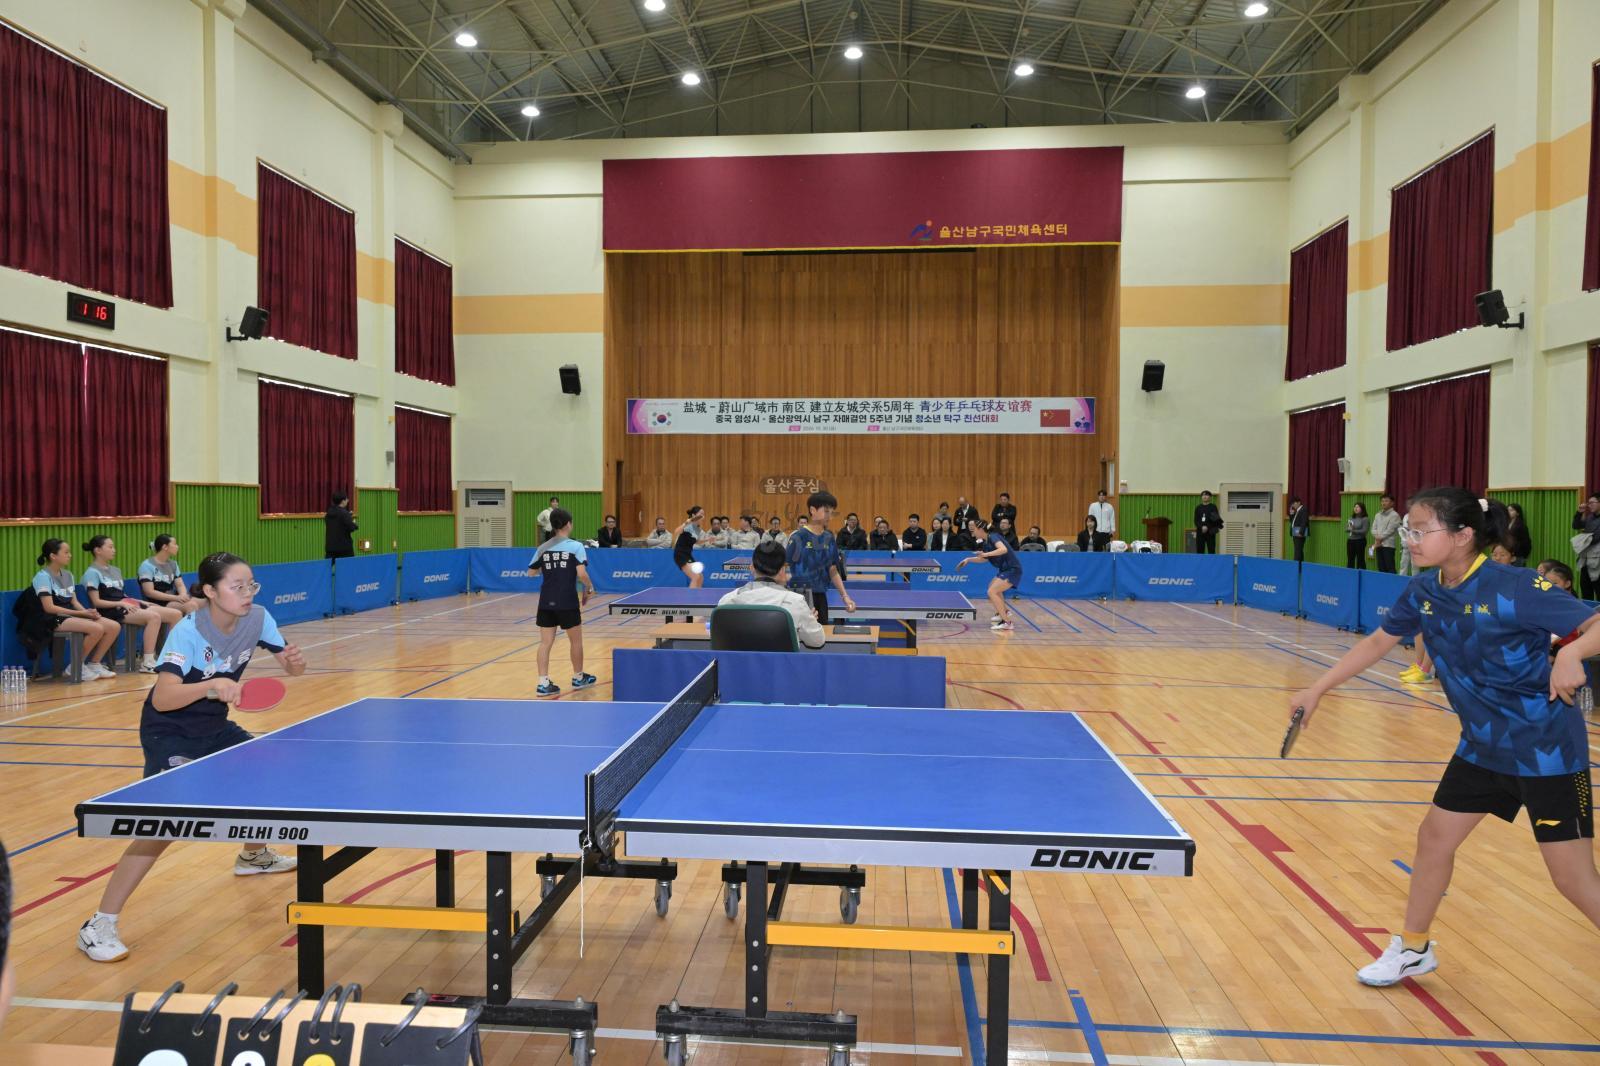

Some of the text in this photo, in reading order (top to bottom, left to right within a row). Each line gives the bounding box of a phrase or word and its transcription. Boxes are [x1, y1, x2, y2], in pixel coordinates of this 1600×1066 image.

[939, 223, 1068, 239] 울산남구국민체육센터
[683, 401, 707, 413] 盐城
[718, 401, 779, 414] 蔚山广域市
[782, 401, 806, 414] 南区
[715, 414, 732, 424] 중국
[734, 414, 760, 424] 염성시
[768, 414, 811, 424] 울산광역시
[813, 414, 830, 424] 남구
[832, 414, 867, 424] 자매결연
[869, 414, 893, 424] 5주년
[895, 414, 913, 424] 기념
[915, 414, 941, 424] 청소년
[943, 414, 961, 424] 탁구
[963, 413, 999, 423] 친선대회
[764, 478, 820, 494] 울산 중심
[423, 573, 450, 583] DONIC
[612, 571, 652, 579] DONIC
[710, 572, 750, 580] DONIC
[926, 574, 968, 582] DONIC
[1035, 575, 1078, 583] DONIC
[355, 581, 380, 593] DONIC
[1148, 577, 1194, 586] DONIC
[1252, 583, 1277, 593] DONIC
[274, 591, 308, 604] DONIC
[1316, 593, 1339, 606] DONIC
[110, 818, 308, 840] DONIC DELHI 900
[1030, 848, 1154, 871] DONIC
